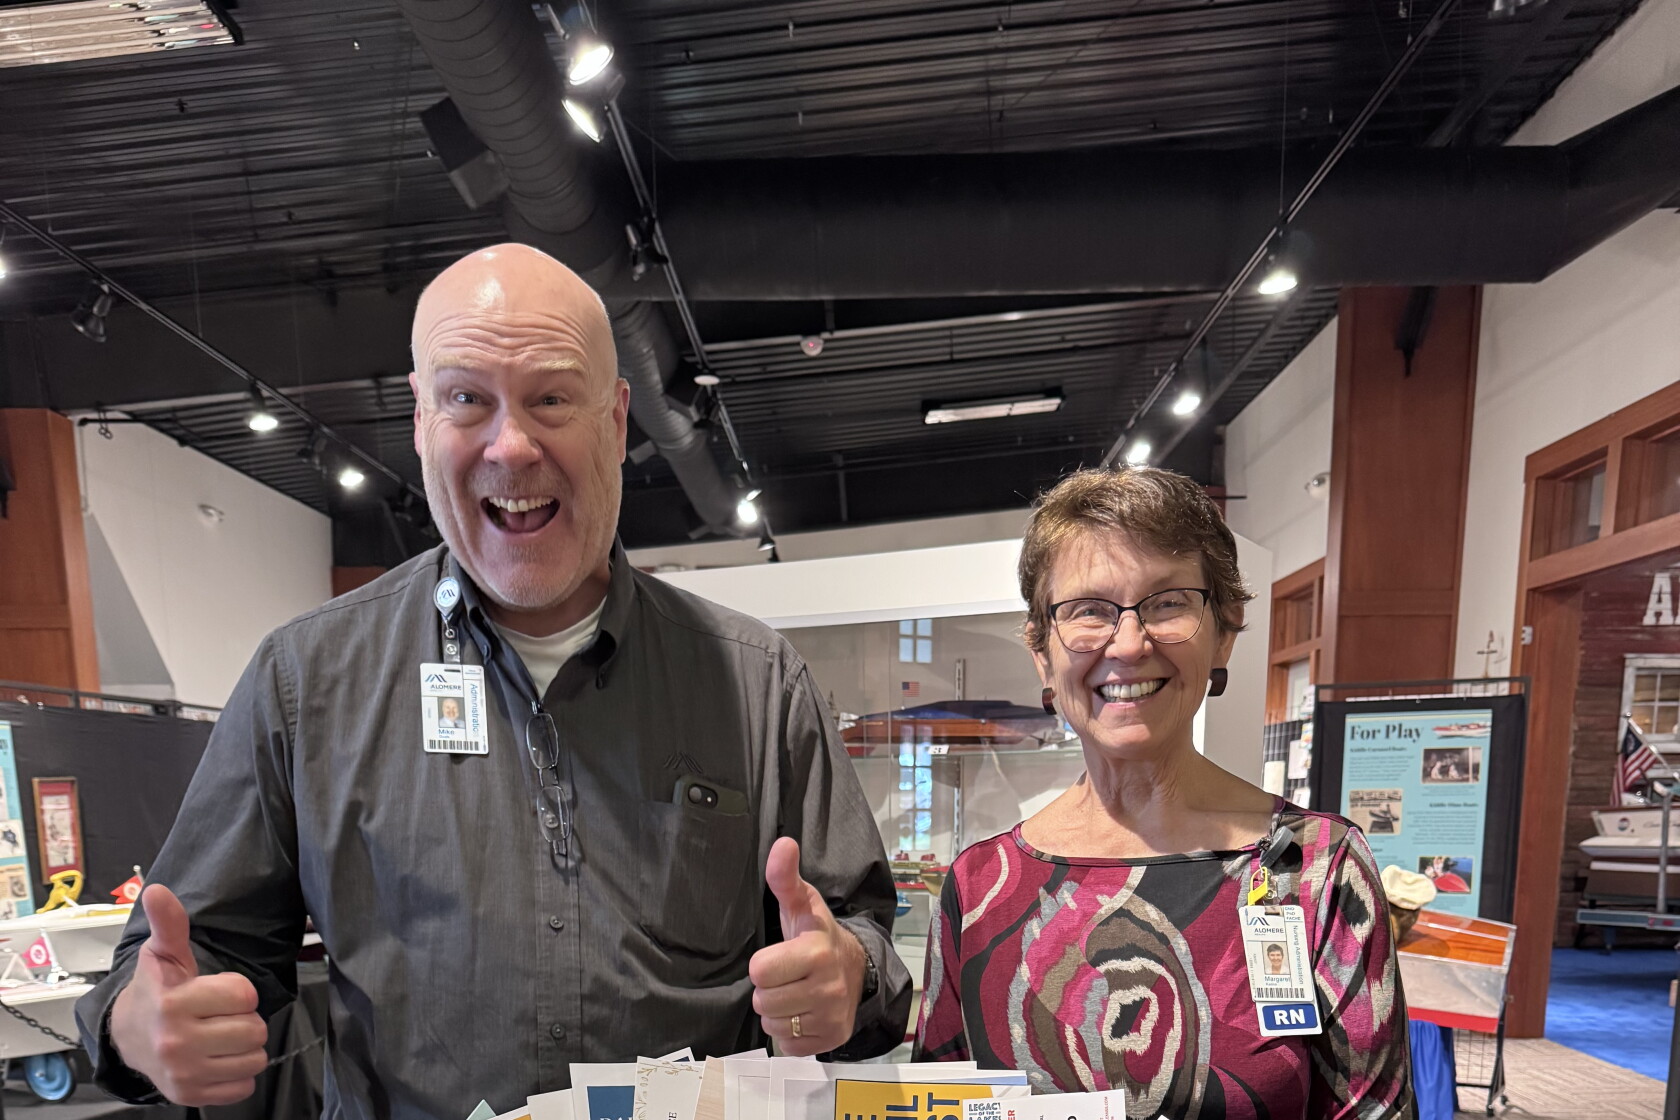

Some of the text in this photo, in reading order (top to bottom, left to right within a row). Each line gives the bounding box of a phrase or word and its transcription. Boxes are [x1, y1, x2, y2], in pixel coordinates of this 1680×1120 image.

[1642, 572, 1680, 626] A
[470, 683, 480, 737] Administratio
[1350, 722, 1424, 744] For Play
[1273, 1008, 1306, 1026] RN
